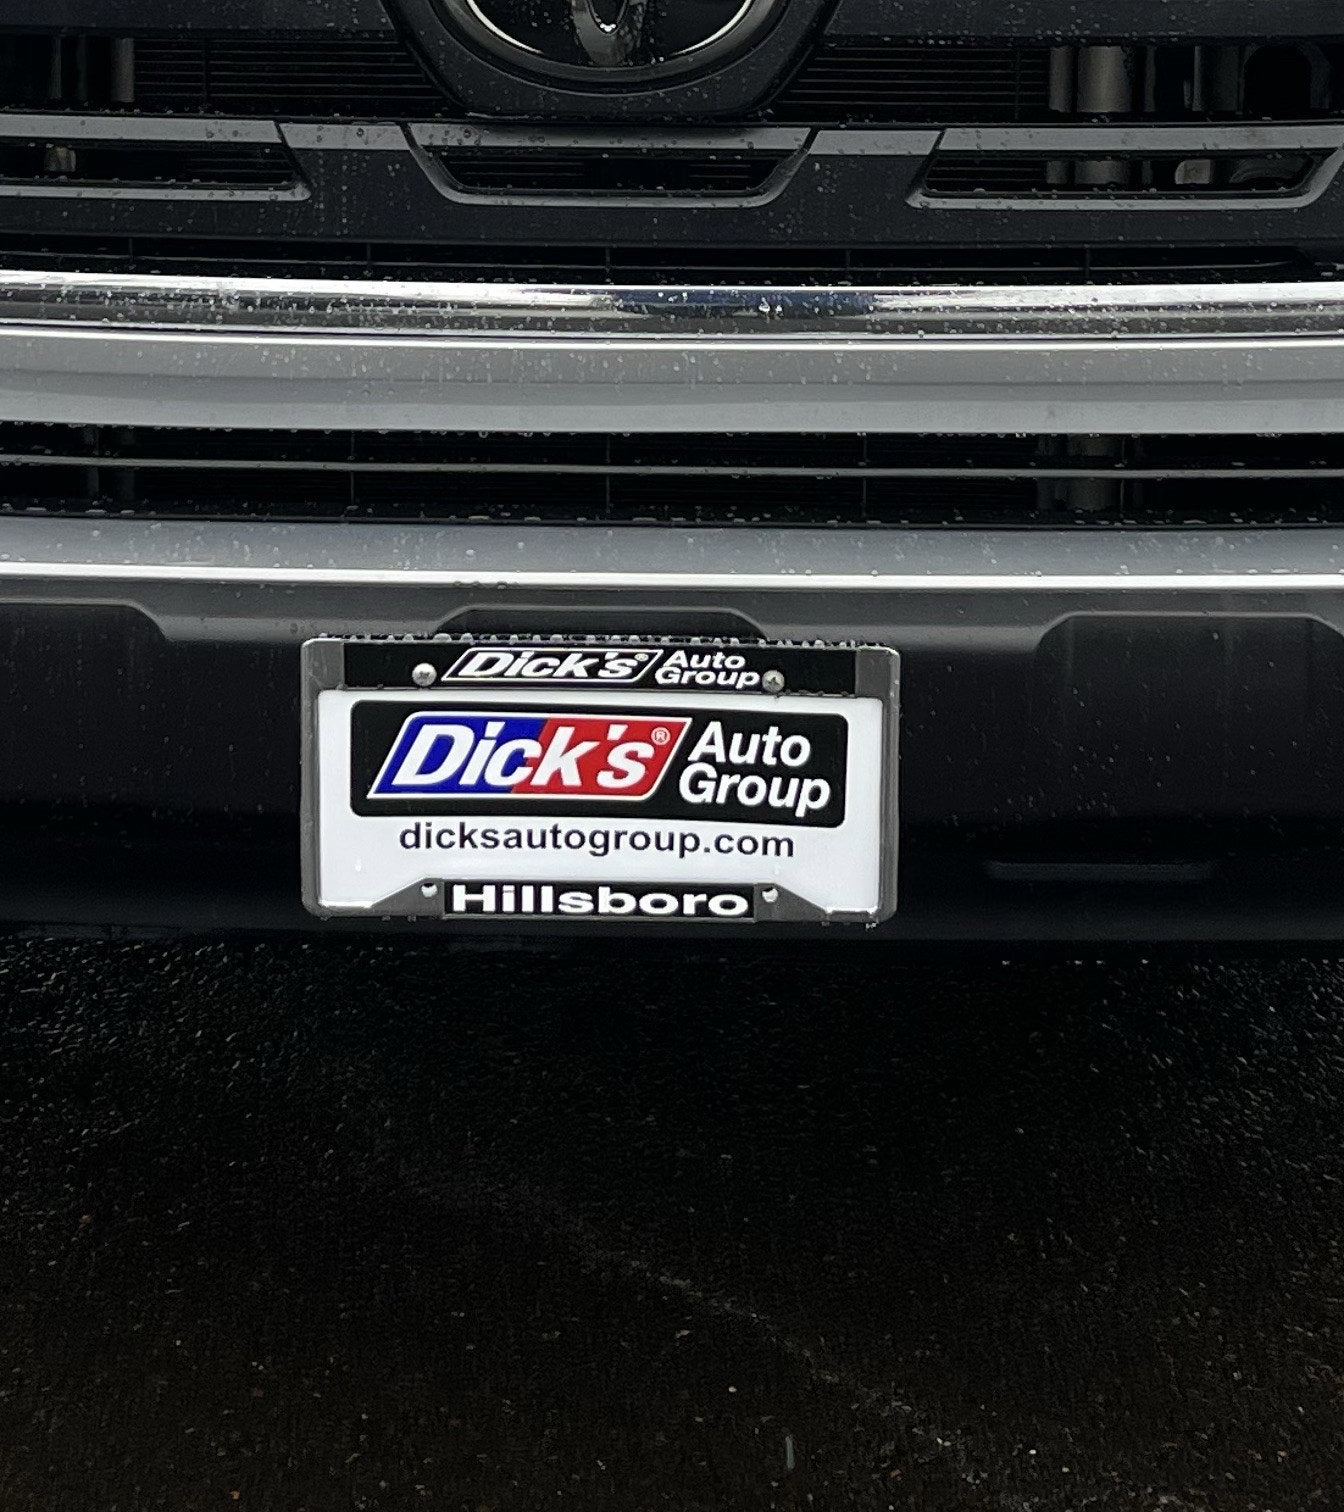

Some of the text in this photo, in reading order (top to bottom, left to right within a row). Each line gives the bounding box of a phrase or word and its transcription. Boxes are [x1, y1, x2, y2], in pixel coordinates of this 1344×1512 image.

[662, 649, 747, 670] Auto
[655, 666, 760, 689] Group
[687, 721, 811, 766] Auto
[678, 763, 831, 817] Group
[399, 821, 795, 858] dicksautogroup.com
[451, 884, 749, 916] Hillsboro
